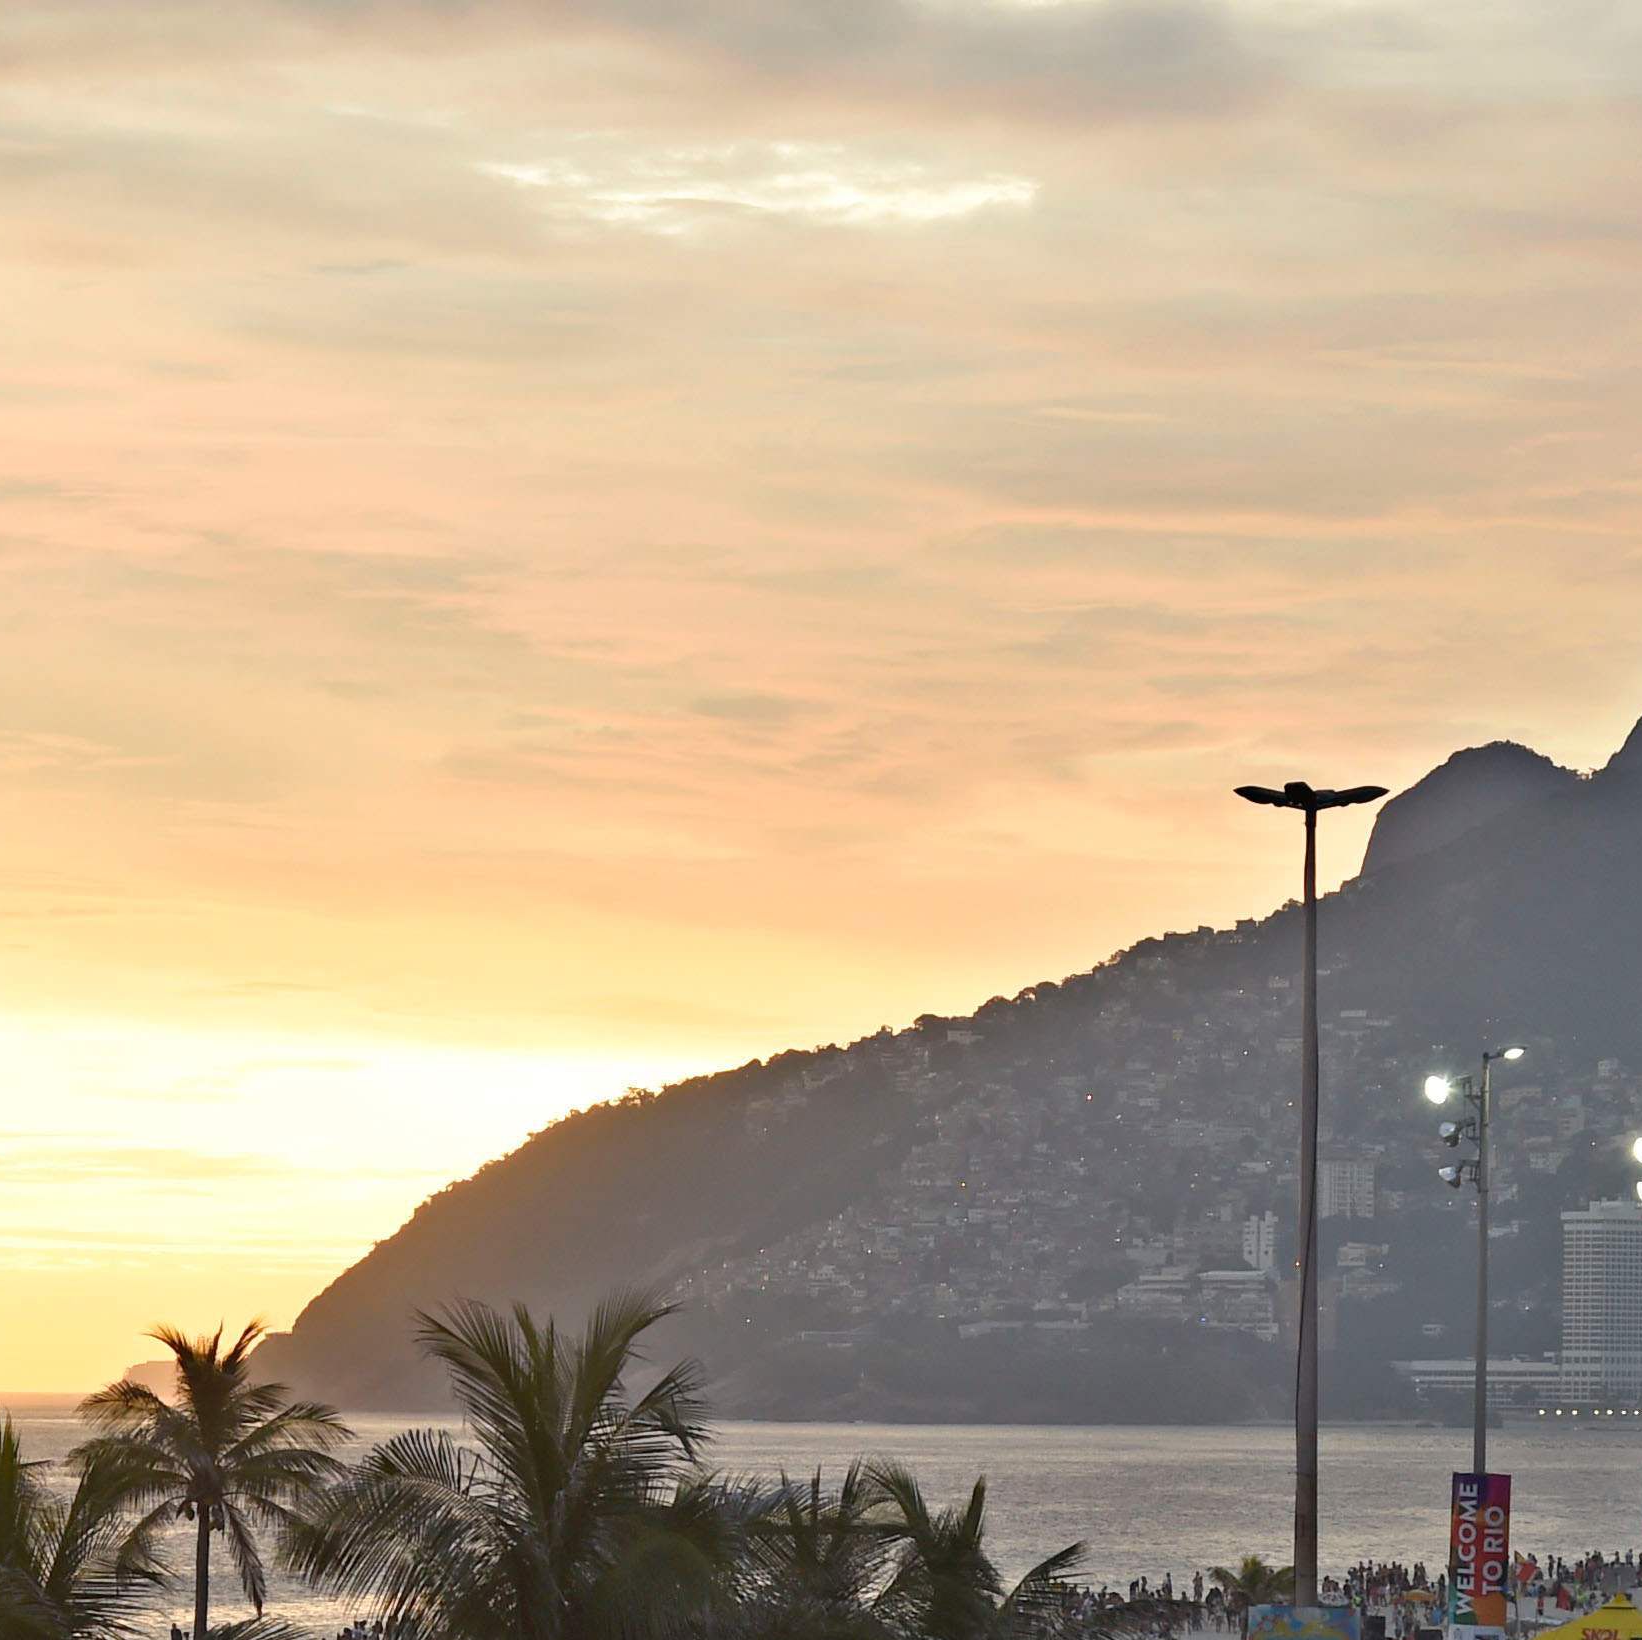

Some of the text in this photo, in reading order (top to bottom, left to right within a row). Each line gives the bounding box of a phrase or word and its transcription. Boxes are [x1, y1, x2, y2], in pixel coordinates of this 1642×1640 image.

[1456, 1483, 1478, 1615] WELCOME
[1481, 1506, 1505, 1595] TO RIO
